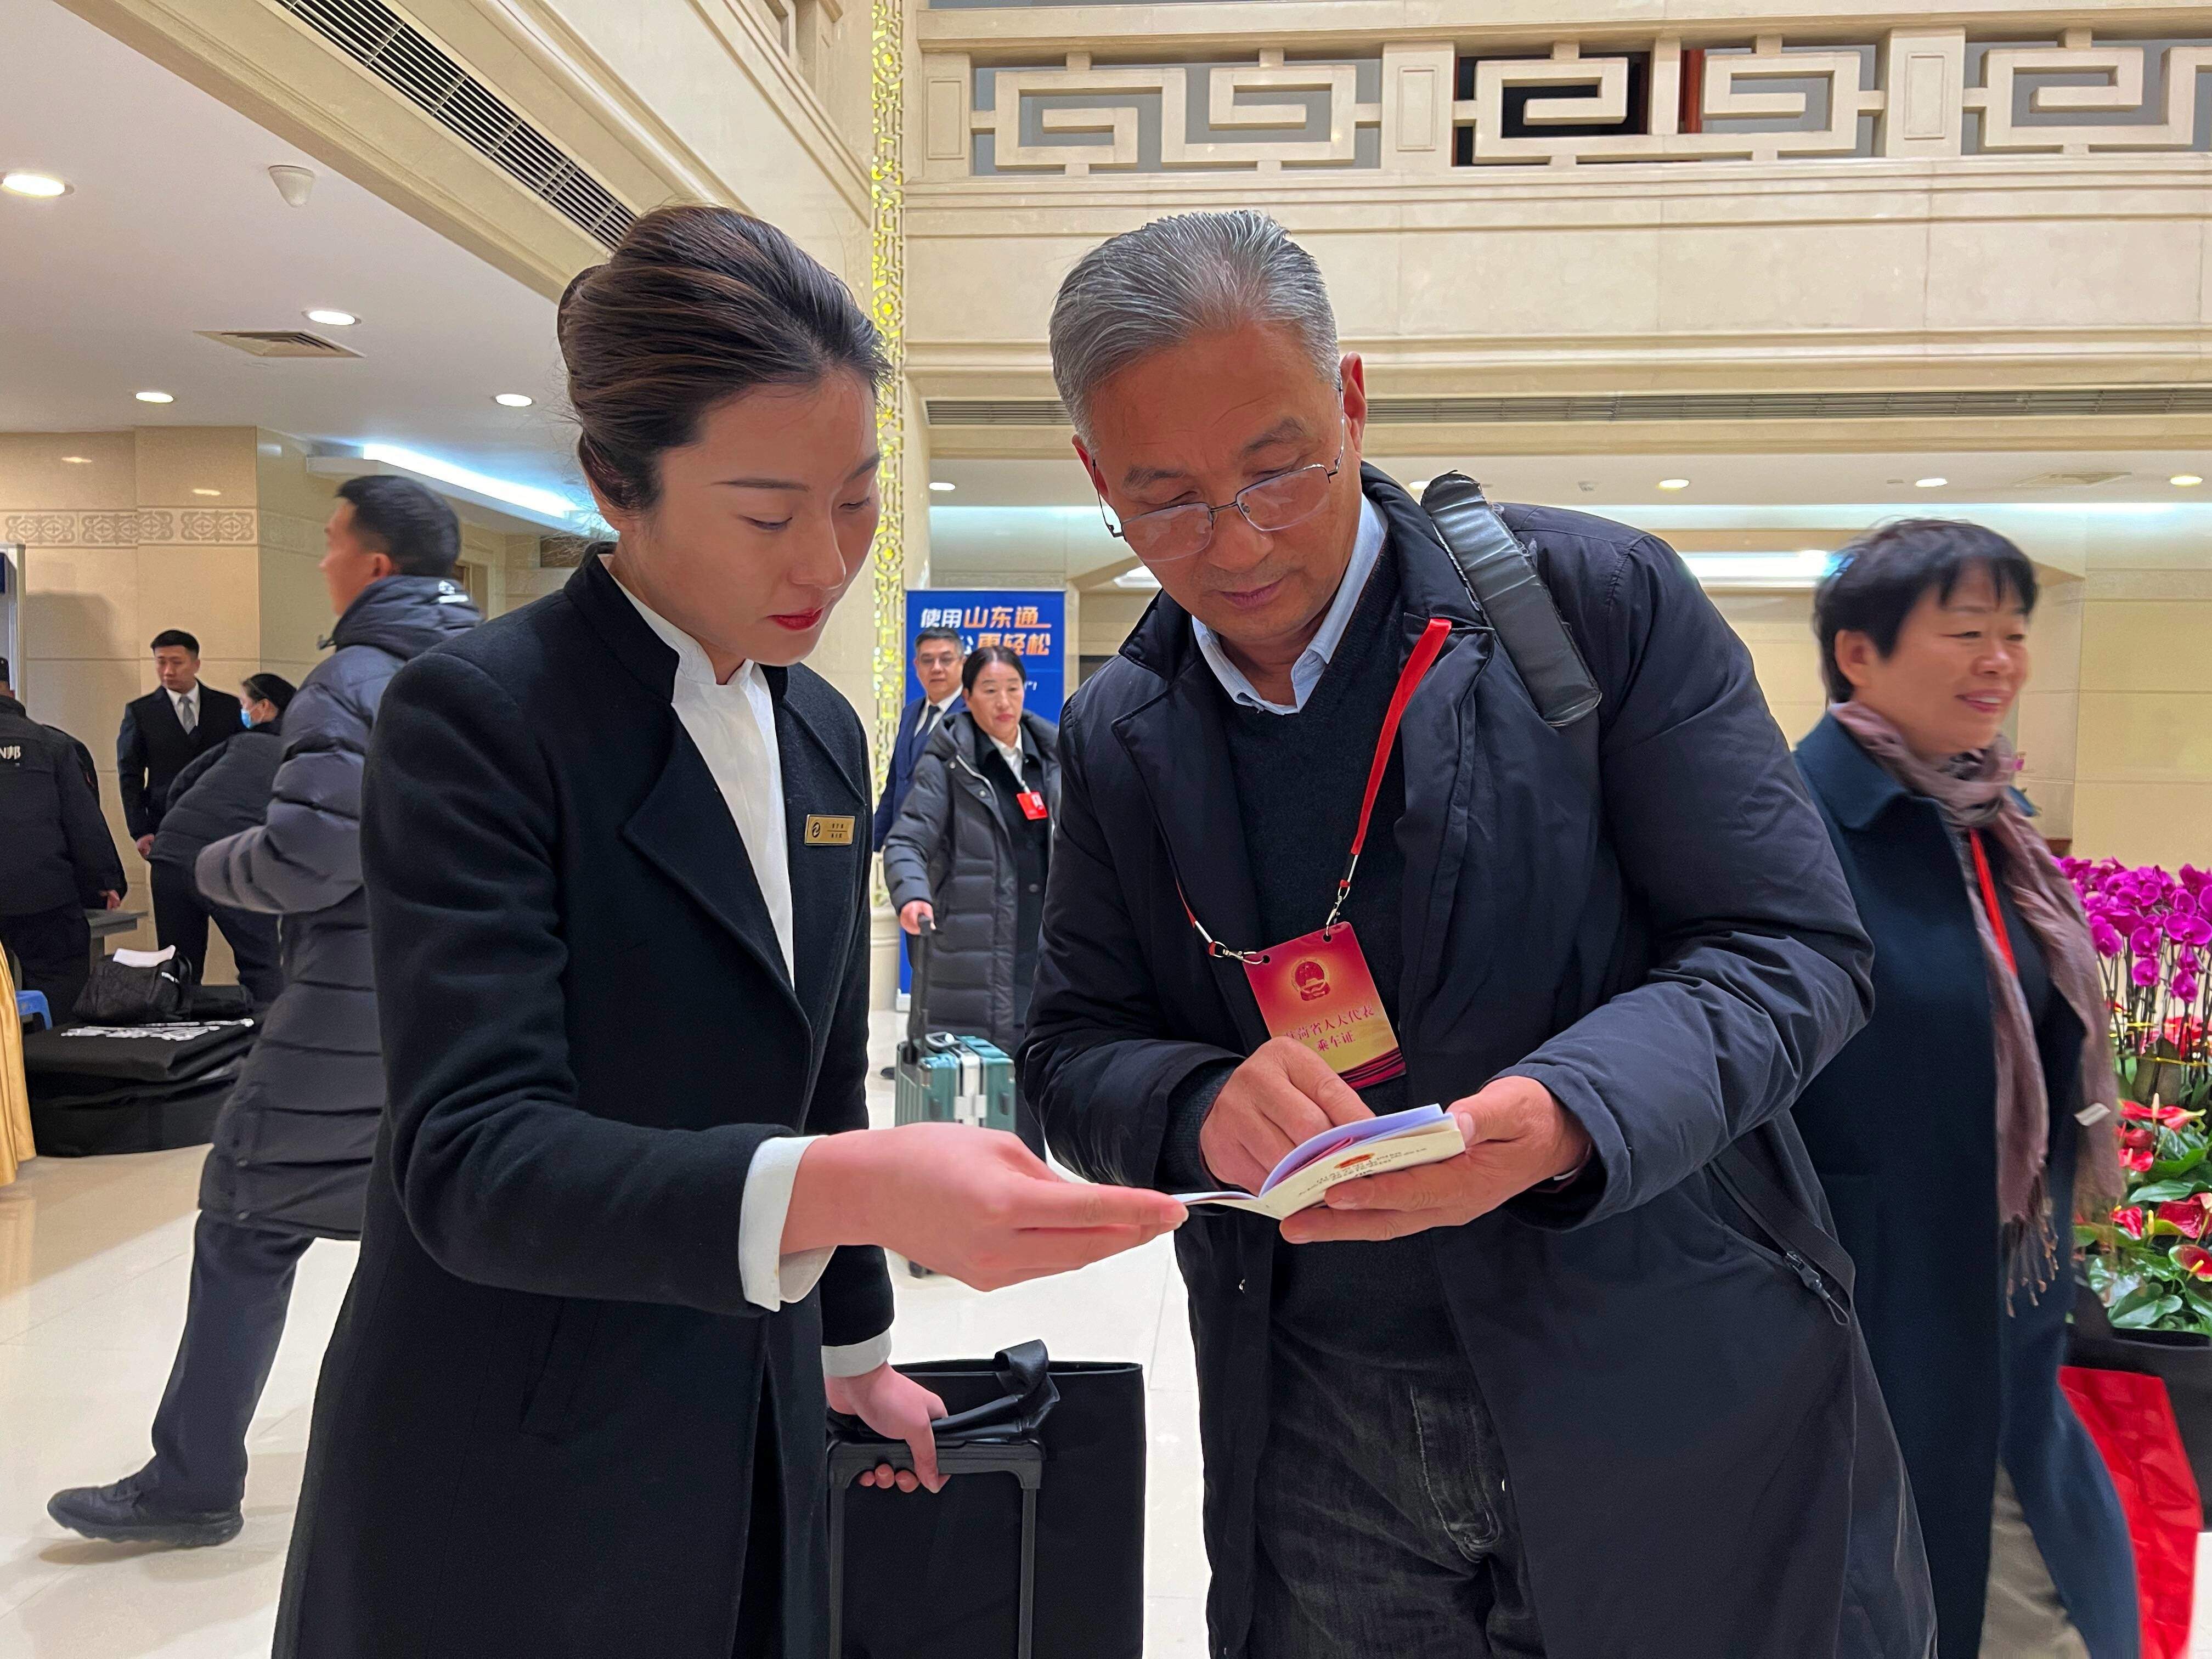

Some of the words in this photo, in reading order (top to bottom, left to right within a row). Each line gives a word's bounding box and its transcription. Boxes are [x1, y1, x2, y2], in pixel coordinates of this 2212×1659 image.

[921, 606, 1052, 628] 使用山东通
[1317, 1030, 1355, 1052] 乘车证
